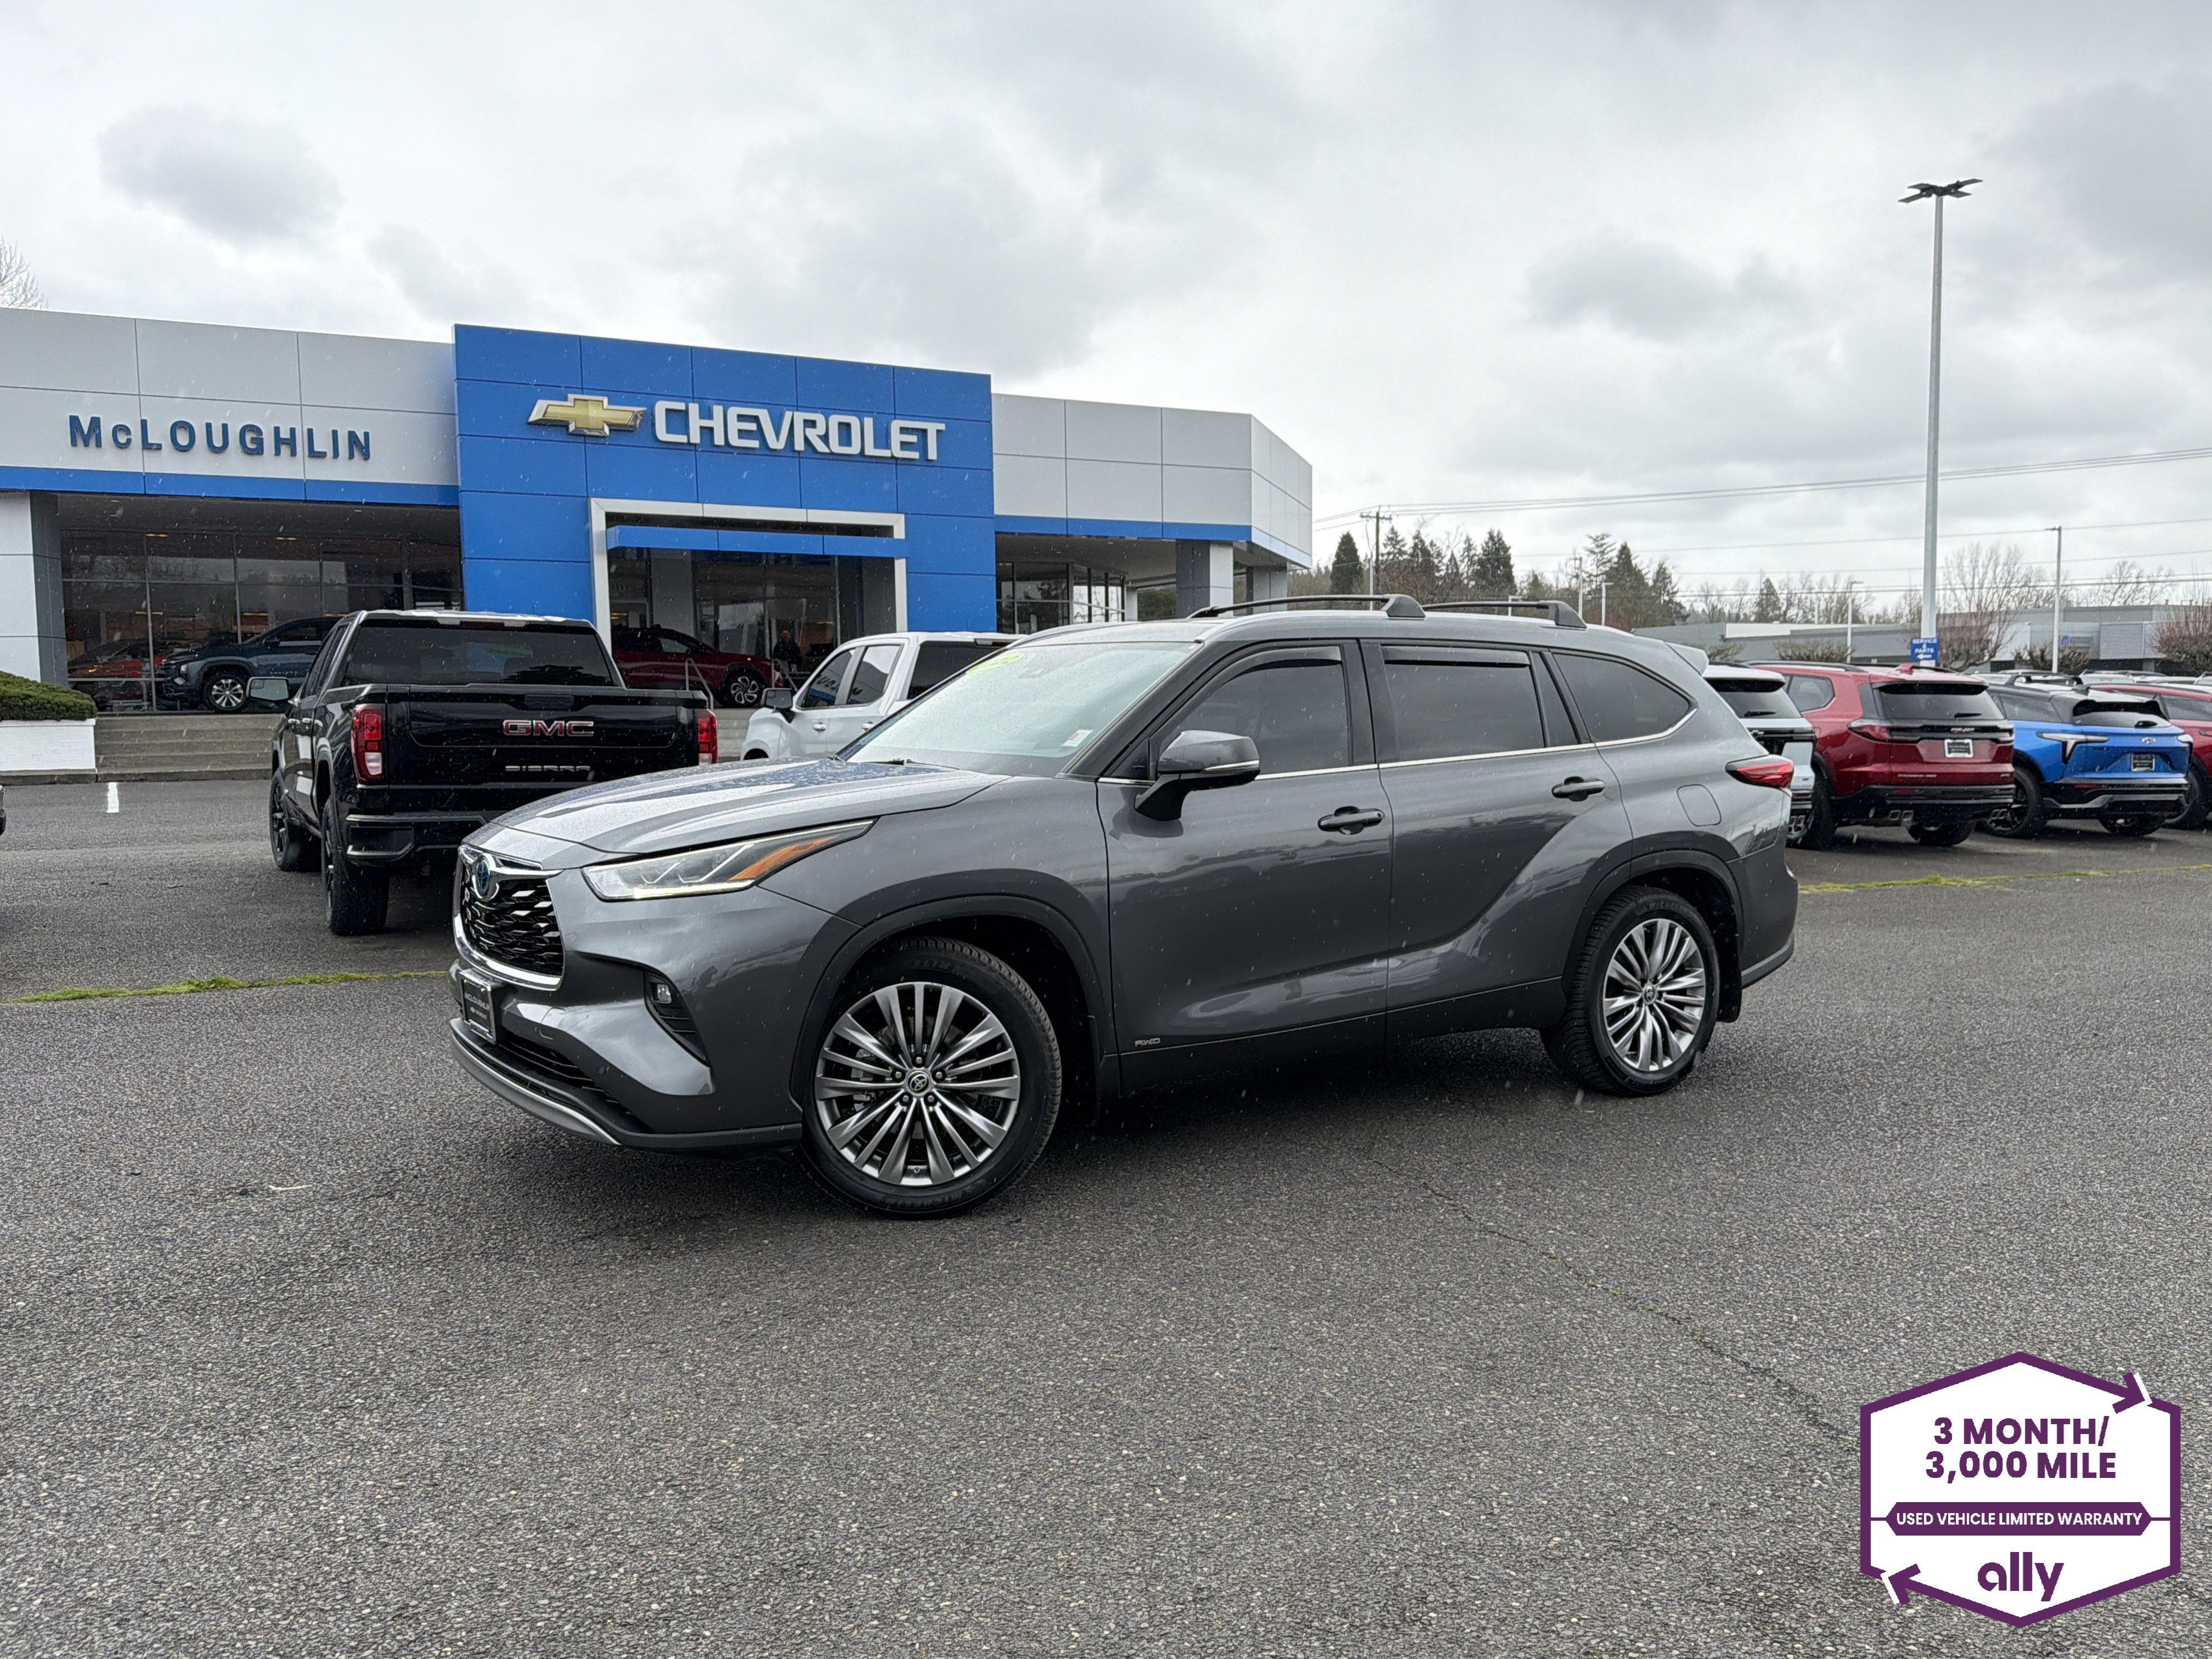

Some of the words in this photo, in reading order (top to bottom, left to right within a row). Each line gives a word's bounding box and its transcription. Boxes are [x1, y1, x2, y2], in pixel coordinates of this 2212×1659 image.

[69, 414, 371, 461] McLOUGHLIN
[654, 400, 946, 461] CHEVROLET
[503, 719, 594, 737] GMC
